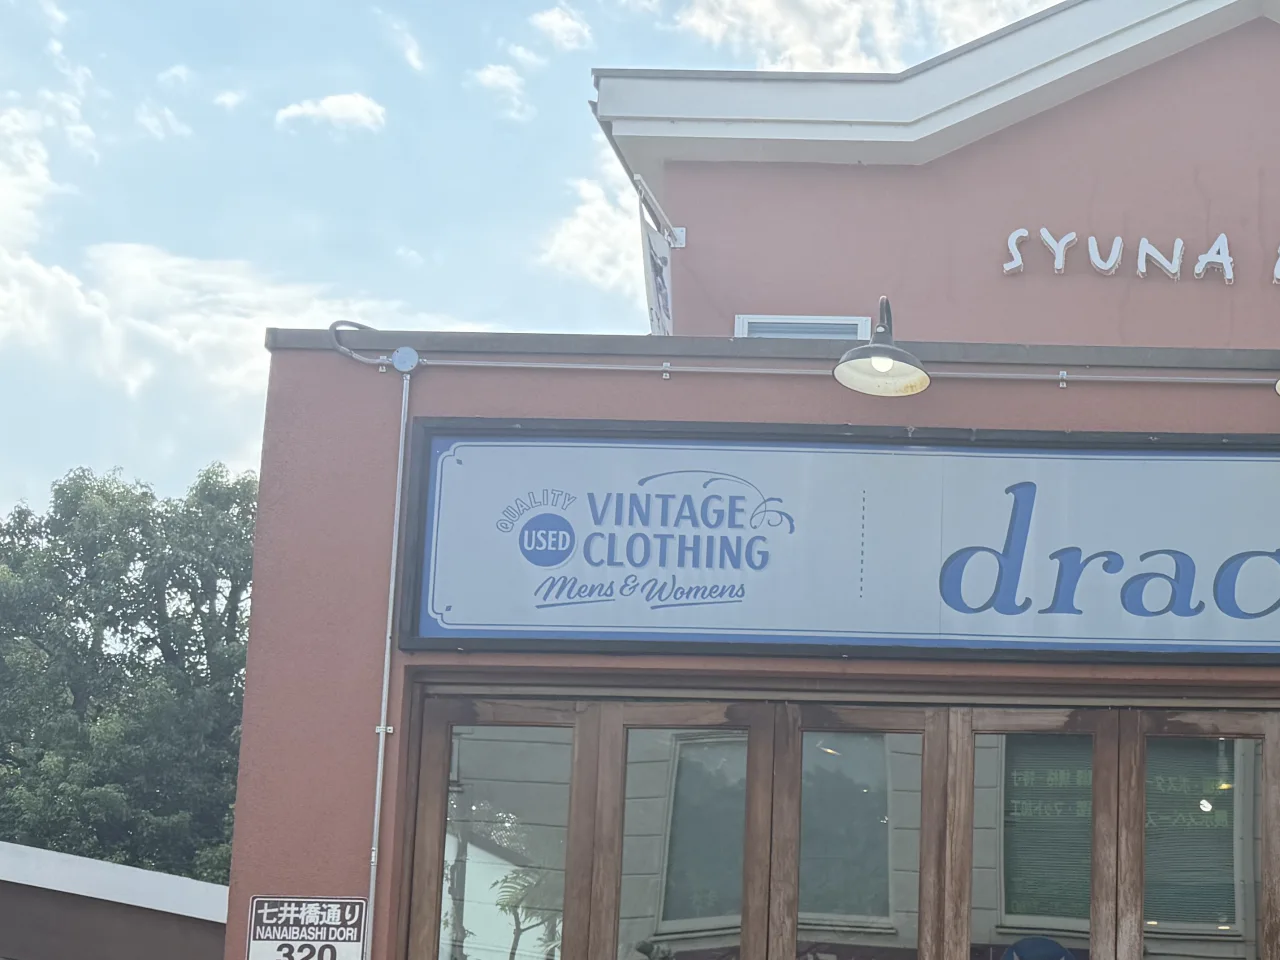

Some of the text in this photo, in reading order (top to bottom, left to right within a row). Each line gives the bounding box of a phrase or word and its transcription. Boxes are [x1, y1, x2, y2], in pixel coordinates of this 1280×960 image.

[1003, 228, 1234, 285] SYUNA
[496, 489, 577, 532] QUALITY
[587, 492, 746, 529] VINTAGE
[523, 529, 572, 551] USED
[583, 532, 770, 570] CLOTHING
[534, 575, 615, 601] Mens
[640, 574, 746, 602] Womens
[257, 902, 360, 926] 七井橋通り
[255, 926, 358, 941] NANAIBASHI DORI
